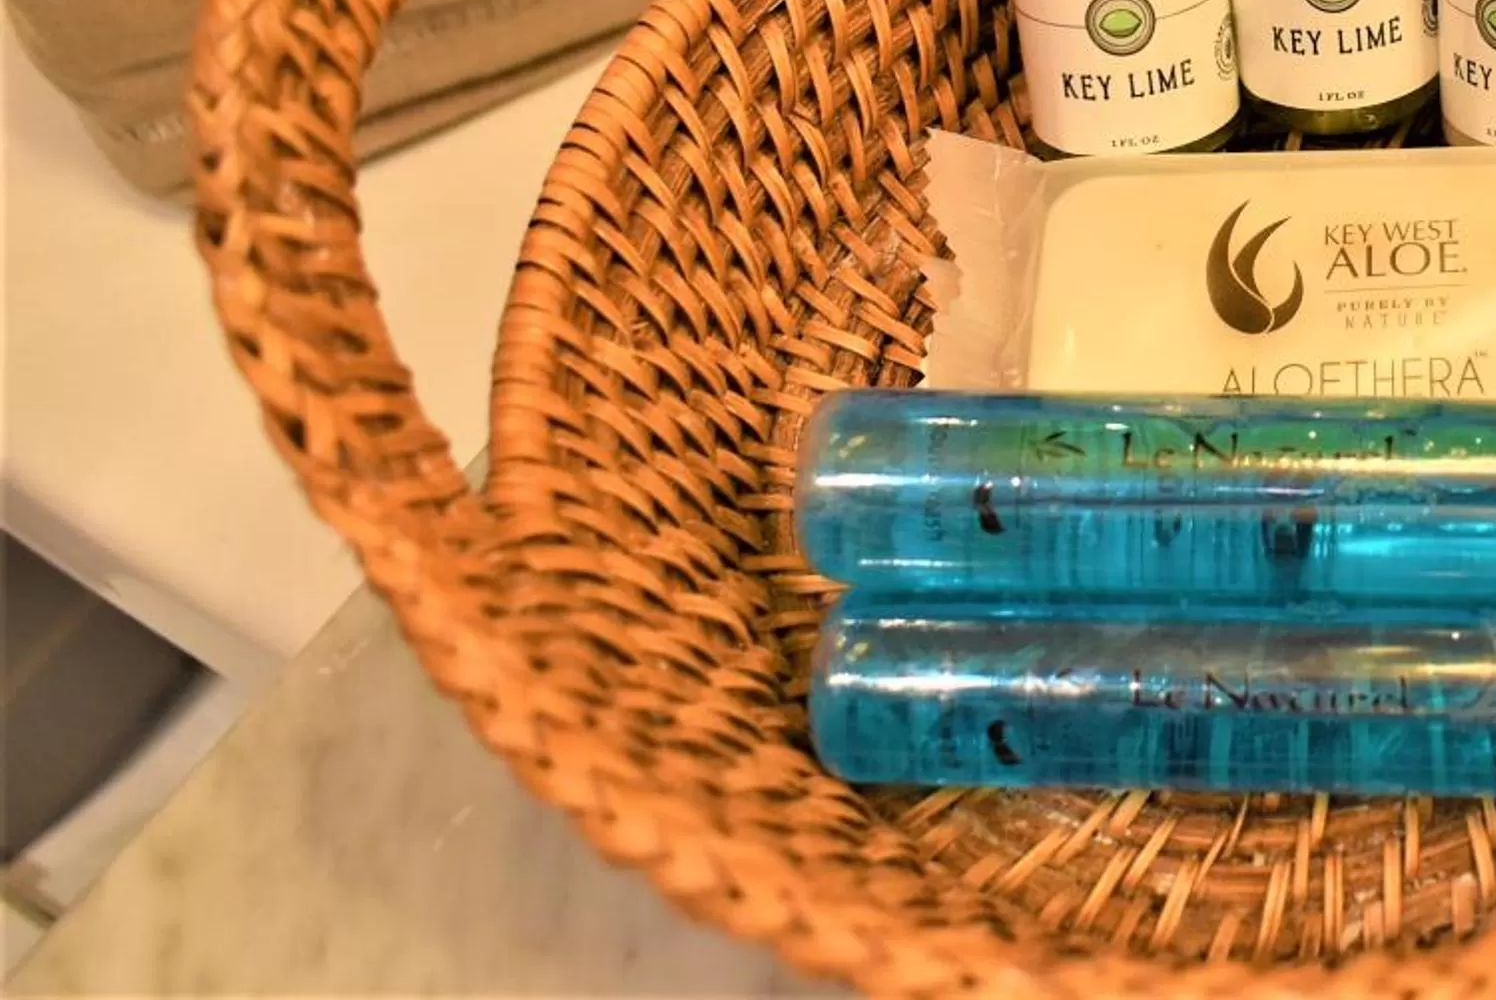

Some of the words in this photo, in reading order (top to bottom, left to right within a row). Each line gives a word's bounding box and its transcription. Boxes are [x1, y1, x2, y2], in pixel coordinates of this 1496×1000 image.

[1272, 25, 1322, 56] KEY
[1337, 16, 1404, 55] LIME
[1062, 72, 1112, 102] KEY
[1129, 58, 1196, 99] LIME
[1453, 52, 1493, 91] KEY
[1325, 223, 1372, 246] KEY
[1382, 218, 1459, 243] WEST
[1336, 297, 1413, 313] PURELY
[1425, 296, 1448, 309] BY
[1344, 312, 1442, 330] NATURE
